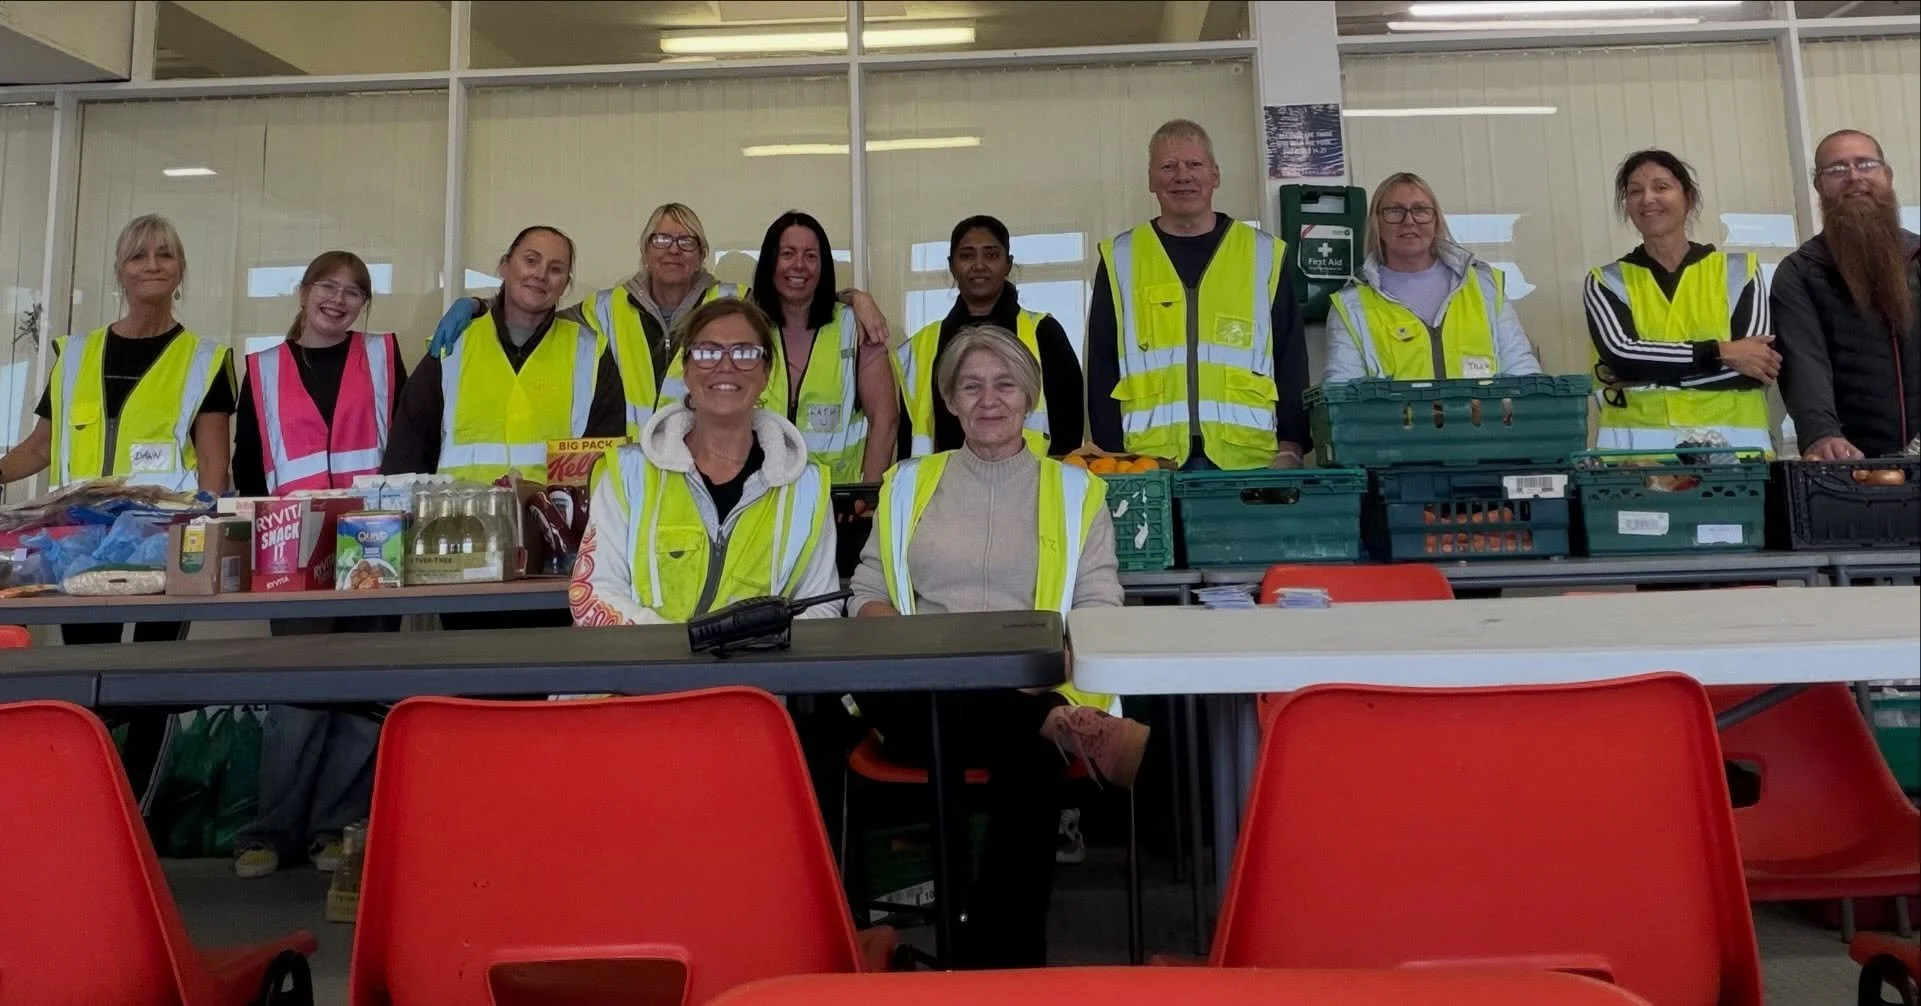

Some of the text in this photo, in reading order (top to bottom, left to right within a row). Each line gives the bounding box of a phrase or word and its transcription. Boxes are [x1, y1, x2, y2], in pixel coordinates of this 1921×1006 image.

[1308, 257, 1342, 266] First Aid
[558, 440, 614, 451] BIG PACK
[134, 449, 162, 461] DAWN
[261, 521, 300, 550] SNACK
[273, 541, 286, 562] IT
[266, 576, 290, 589] RYVITA
